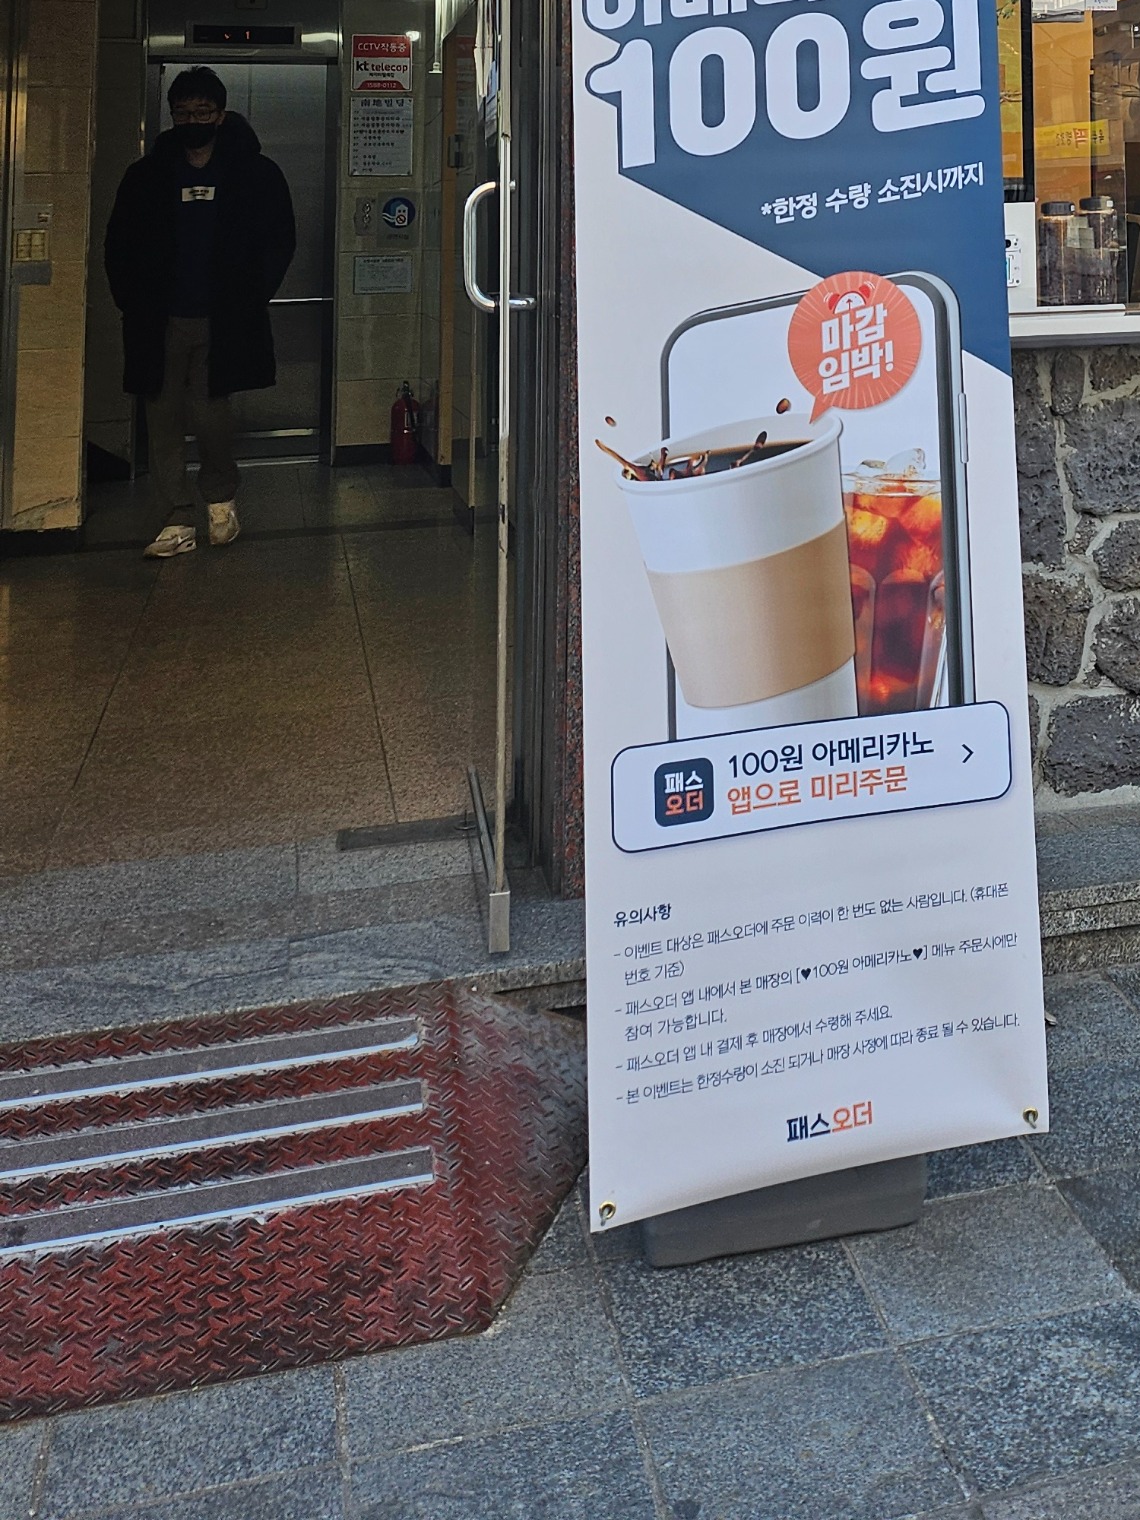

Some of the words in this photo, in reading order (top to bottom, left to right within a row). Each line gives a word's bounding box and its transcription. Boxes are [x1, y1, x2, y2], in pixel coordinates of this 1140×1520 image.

[356, 60, 370, 72] kt
[371, 62, 408, 74] telecop
[357, 42, 407, 53] CCTV작동중
[824, 183, 871, 210] 수량
[877, 162, 984, 205] 소진시까지
[820, 305, 887, 355] 마감
[818, 341, 894, 396] 임박!
[728, 743, 804, 779] 100원
[811, 731, 935, 767] 아메리카노
[663, 772, 704, 795] 패스
[664, 792, 704, 816] 오더
[727, 782, 802, 816] 앱으로
[810, 766, 909, 799] 미리주문
[613, 903, 672, 928] 유의사항
[624, 940, 663, 960] 이벤트
[667, 932, 704, 953] 대상은
[707, 921, 768, 945] 패스오더에
[771, 916, 795, 933] 주문
[799, 908, 834, 927] 이력이
[837, 906, 849, 922] 한
[852, 902, 876, 919] 번도
[879, 898, 904, 914] 없는
[906, 888, 967, 910] 사람입니다.
[970, 882, 1009, 903] (휴대폰
[624, 968, 651, 986] 번호
[654, 960, 685, 980] 기준)
[625, 993, 677, 1016] 패스오더
[681, 989, 694, 1006] 앱
[698, 981, 736, 1002] 내에서
[739, 979, 752, 994] 본
[756, 969, 793, 991] 매장의
[931, 943, 955, 959] 메뉴
[959, 932, 1018, 955] 주문시에만
[624, 1024, 653, 1043] 참여
[657, 1008, 727, 1035] 가능합니다.
[626, 1048, 680, 1073] 패스오더
[683, 1045, 696, 1062] 앱
[700, 1041, 713, 1057] 내
[717, 1035, 743, 1054] 결제
[746, 1032, 759, 1047] 후
[763, 1020, 812, 1044] 매장에서
[815, 1011, 852, 1033] 수령해
[855, 1004, 893, 1025] 주세요.
[626, 1088, 640, 1105] 본
[643, 1078, 693, 1100] 이벤트는
[697, 1065, 758, 1091] 한정수량이
[761, 1058, 786, 1076] 소진
[788, 1049, 824, 1069] 되거나
[827, 1044, 851, 1062] 매장
[852, 1035, 888, 1056] 사정에
[890, 1030, 913, 1047] 따라
[915, 1027, 940, 1043] 종료
[942, 1021, 954, 1037] 될
[956, 1020, 969, 1034] 수
[971, 1013, 1020, 1033] 있습니다.
[786, 1101, 873, 1143] 패스오더
